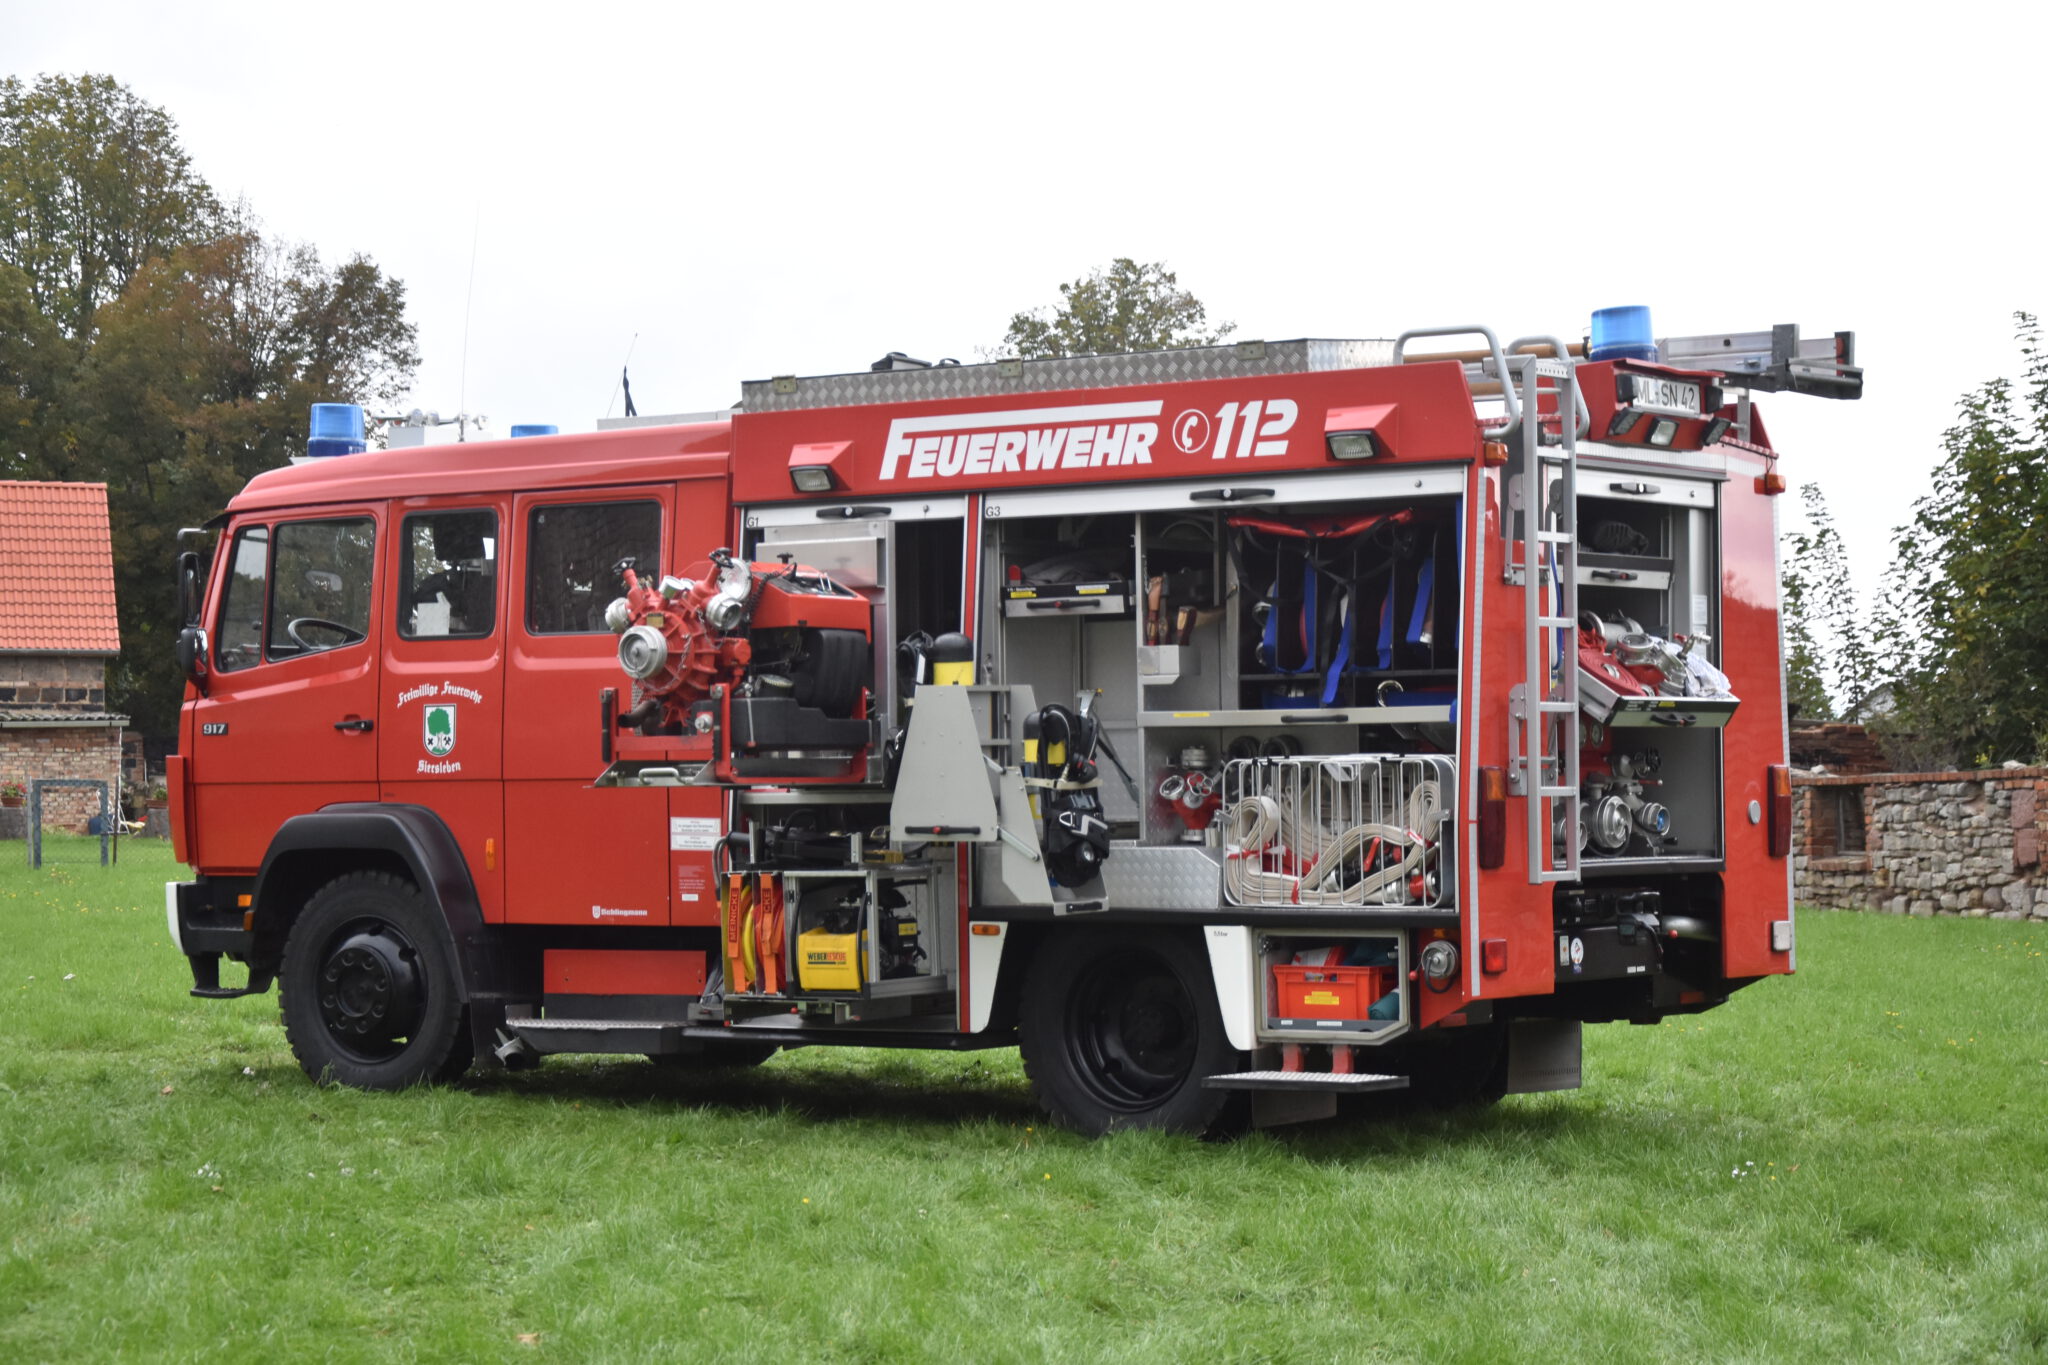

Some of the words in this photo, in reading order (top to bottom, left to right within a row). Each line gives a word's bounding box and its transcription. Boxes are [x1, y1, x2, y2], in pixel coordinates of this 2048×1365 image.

[1637, 379, 1654, 404] ML
[1661, 382, 1678, 408] SN
[1681, 386, 1696, 411] 42
[878, 400, 1164, 480] FEUERWEHR
[1212, 398, 1299, 460] 112
[747, 517, 759, 527] G1
[985, 506, 1001, 517] G3
[397, 683, 438, 708] Freiwillige
[441, 681, 482, 703] Feuerwehr
[203, 723, 226, 735] 917
[730, 888, 739, 941] MEINICKE
